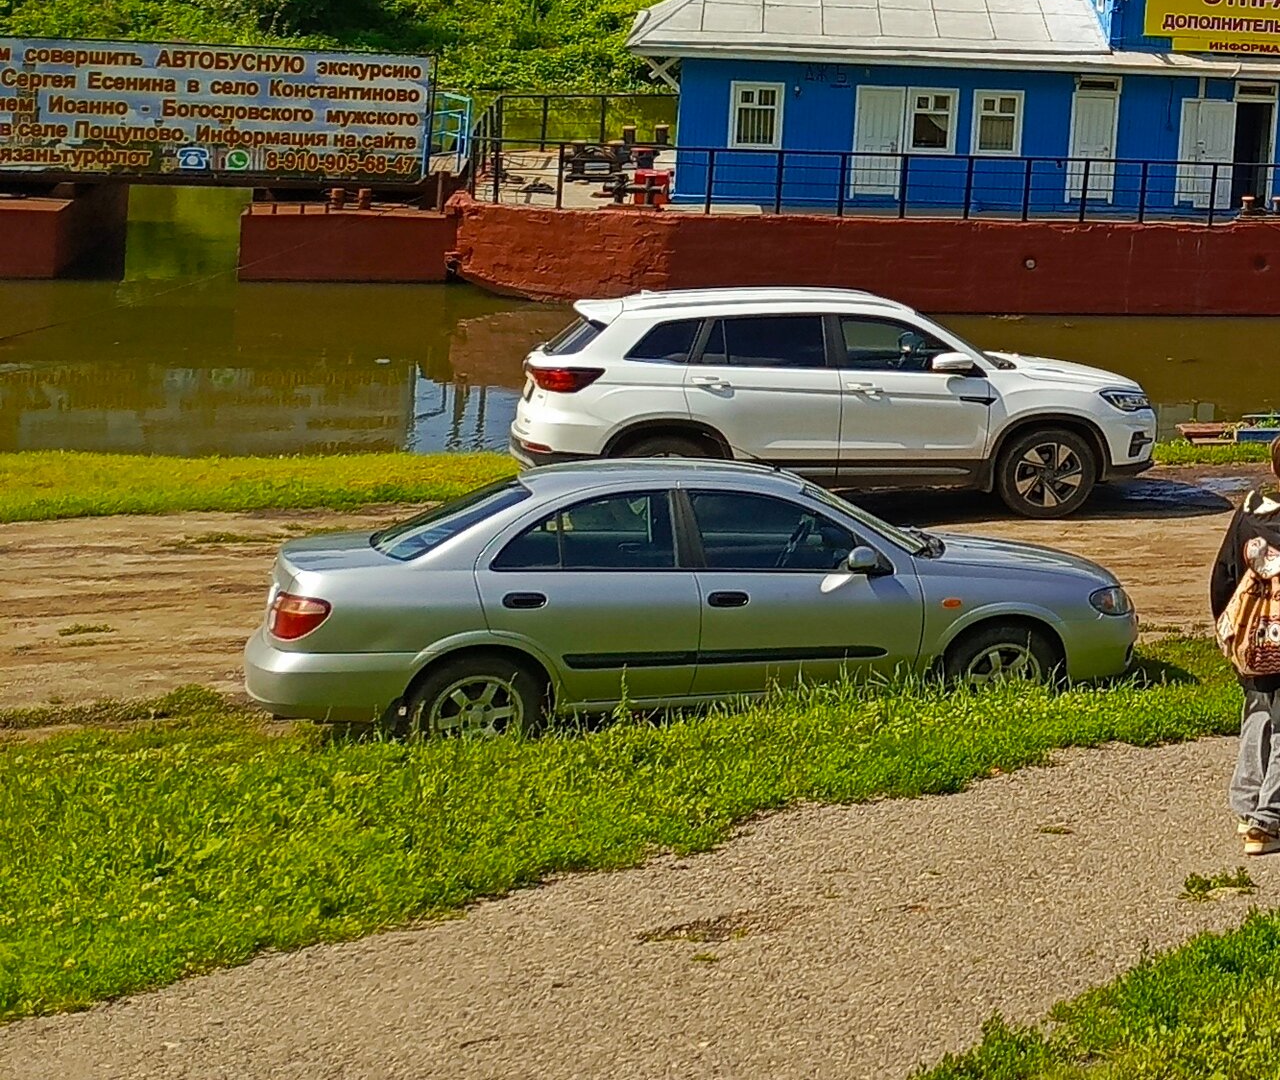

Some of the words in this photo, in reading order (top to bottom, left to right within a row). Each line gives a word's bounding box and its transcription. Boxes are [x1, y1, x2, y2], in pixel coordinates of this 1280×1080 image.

[24, 47, 143, 67] совершить
[156, 49, 305, 74] АВТОБУСНУЮ
[316, 60, 422, 80] экскурсию
[1, 68, 76, 91] Сергея
[87, 71, 176, 92] Есенина
[187, 79, 199, 93] в
[210, 80, 259, 96] село
[269, 79, 420, 103] Константиново
[48, 95, 128, 115] Иоанно
[162, 99, 314, 122] Богословского
[326, 110, 419, 127] мужского
[18, 123, 68, 138] селе
[74, 120, 189, 143] Пощупово.
[195, 125, 328, 147] Информация
[334, 134, 358, 147] на
[362, 132, 417, 149] сайте
[266, 151, 416, 174] 8-910-905-68-47
